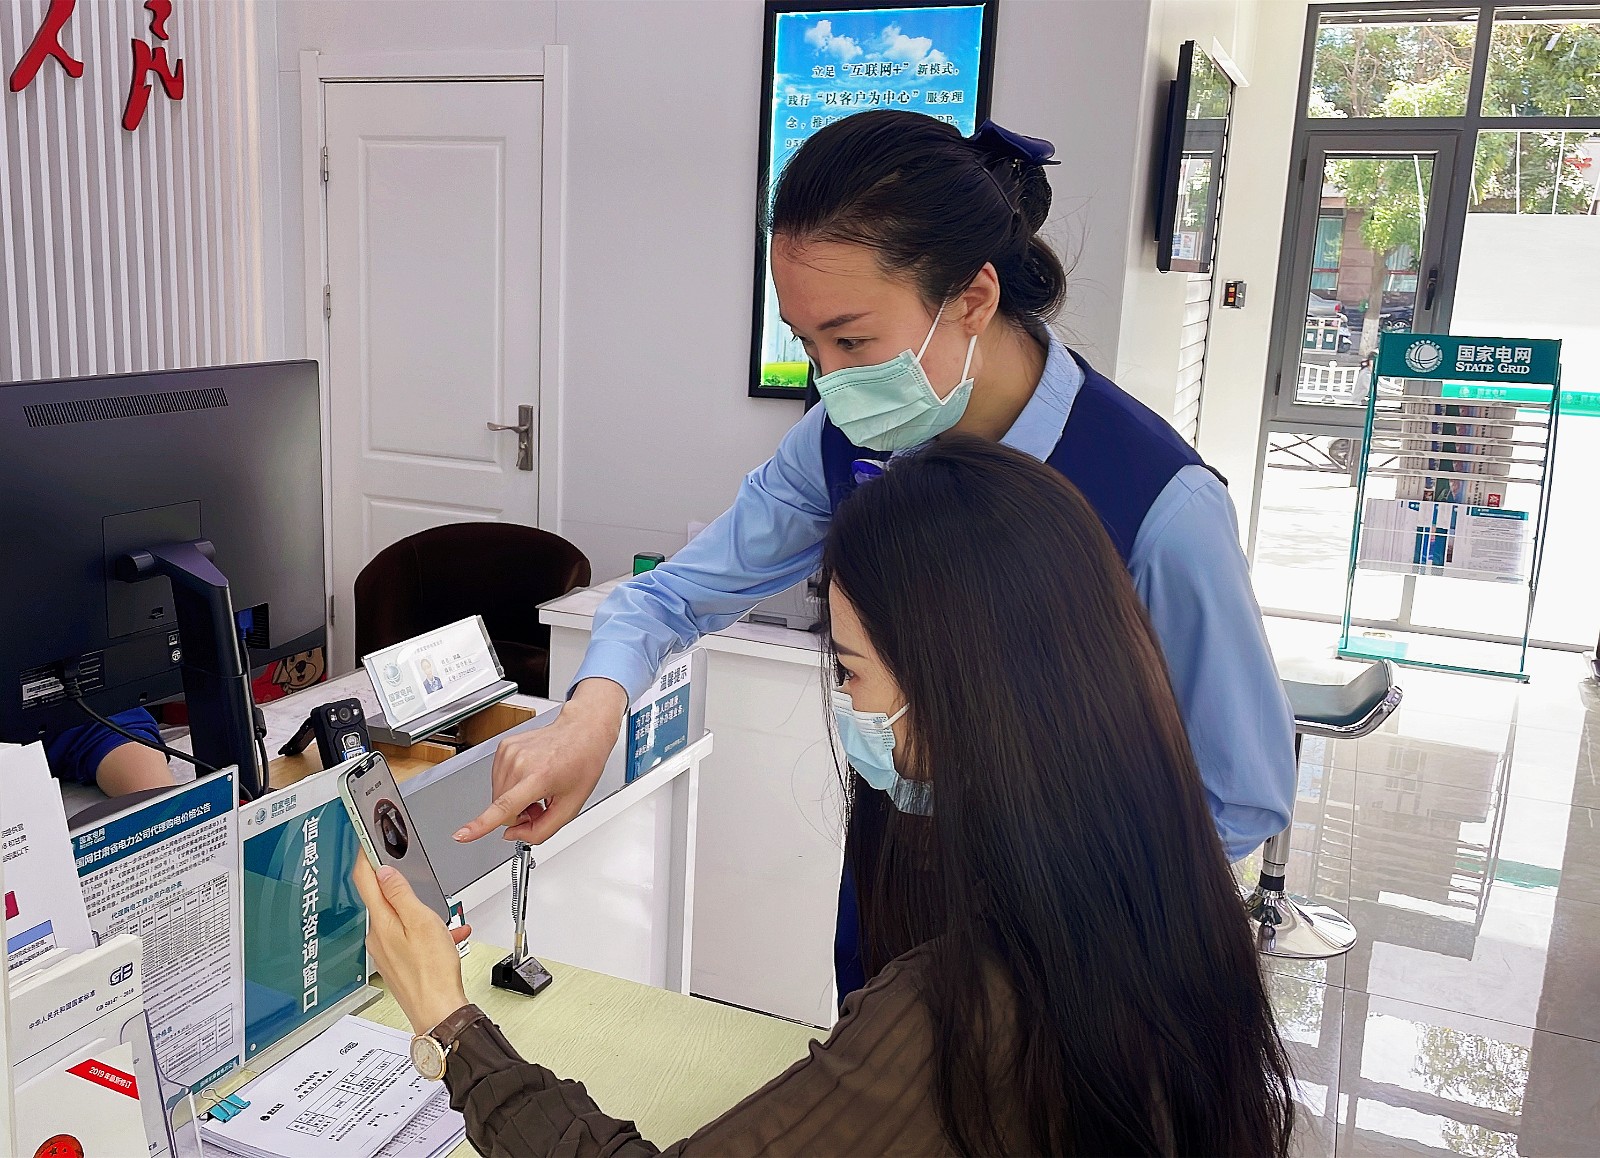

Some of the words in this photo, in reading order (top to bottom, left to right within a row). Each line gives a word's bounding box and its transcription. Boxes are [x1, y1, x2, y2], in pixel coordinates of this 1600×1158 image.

[1455, 361, 1495, 373] STATE
[1498, 363, 1531, 375] GRID
[1457, 344, 1533, 365] 国家电网
[659, 664, 688, 692] 温馨提示
[271, 794, 297, 813] 国家电网
[75, 802, 212, 869] 国网甘肃省电力公司代理购电价格公告
[301, 816, 320, 1014] 信息公开咨询窗口
[108, 961, 134, 987] GB
[28, 989, 96, 1030] 中华人民共和国国家标准
